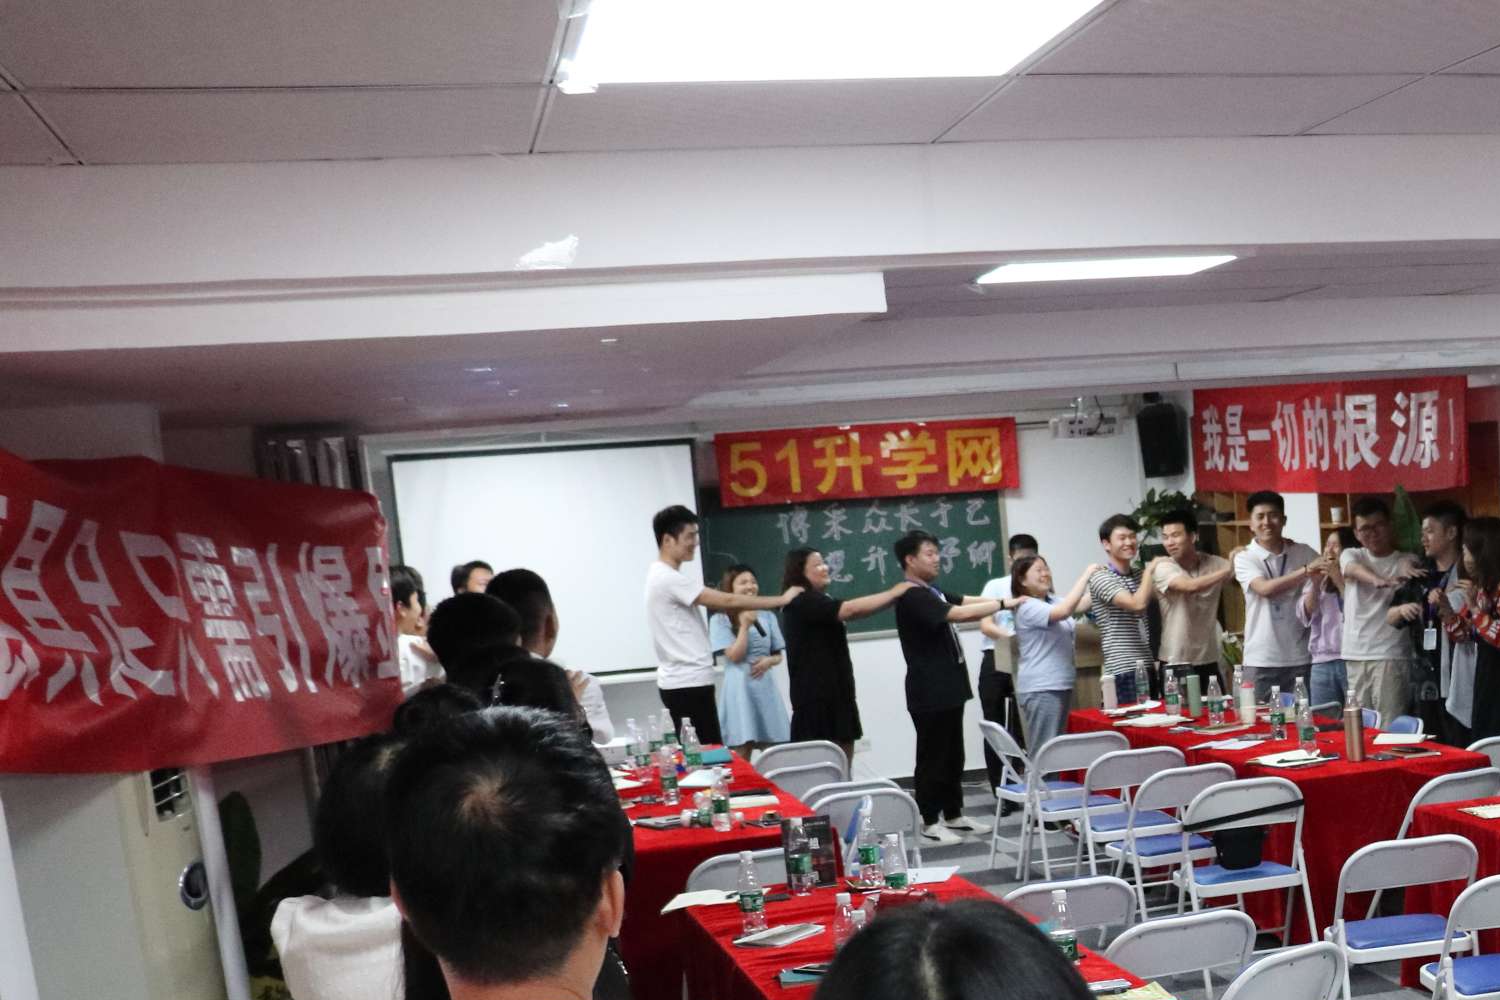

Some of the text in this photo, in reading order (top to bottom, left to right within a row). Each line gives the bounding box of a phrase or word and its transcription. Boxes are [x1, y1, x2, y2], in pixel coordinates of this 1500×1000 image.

[729, 426, 1003, 498] 51升学网
[0, 494, 400, 706] 具足只需引爆
